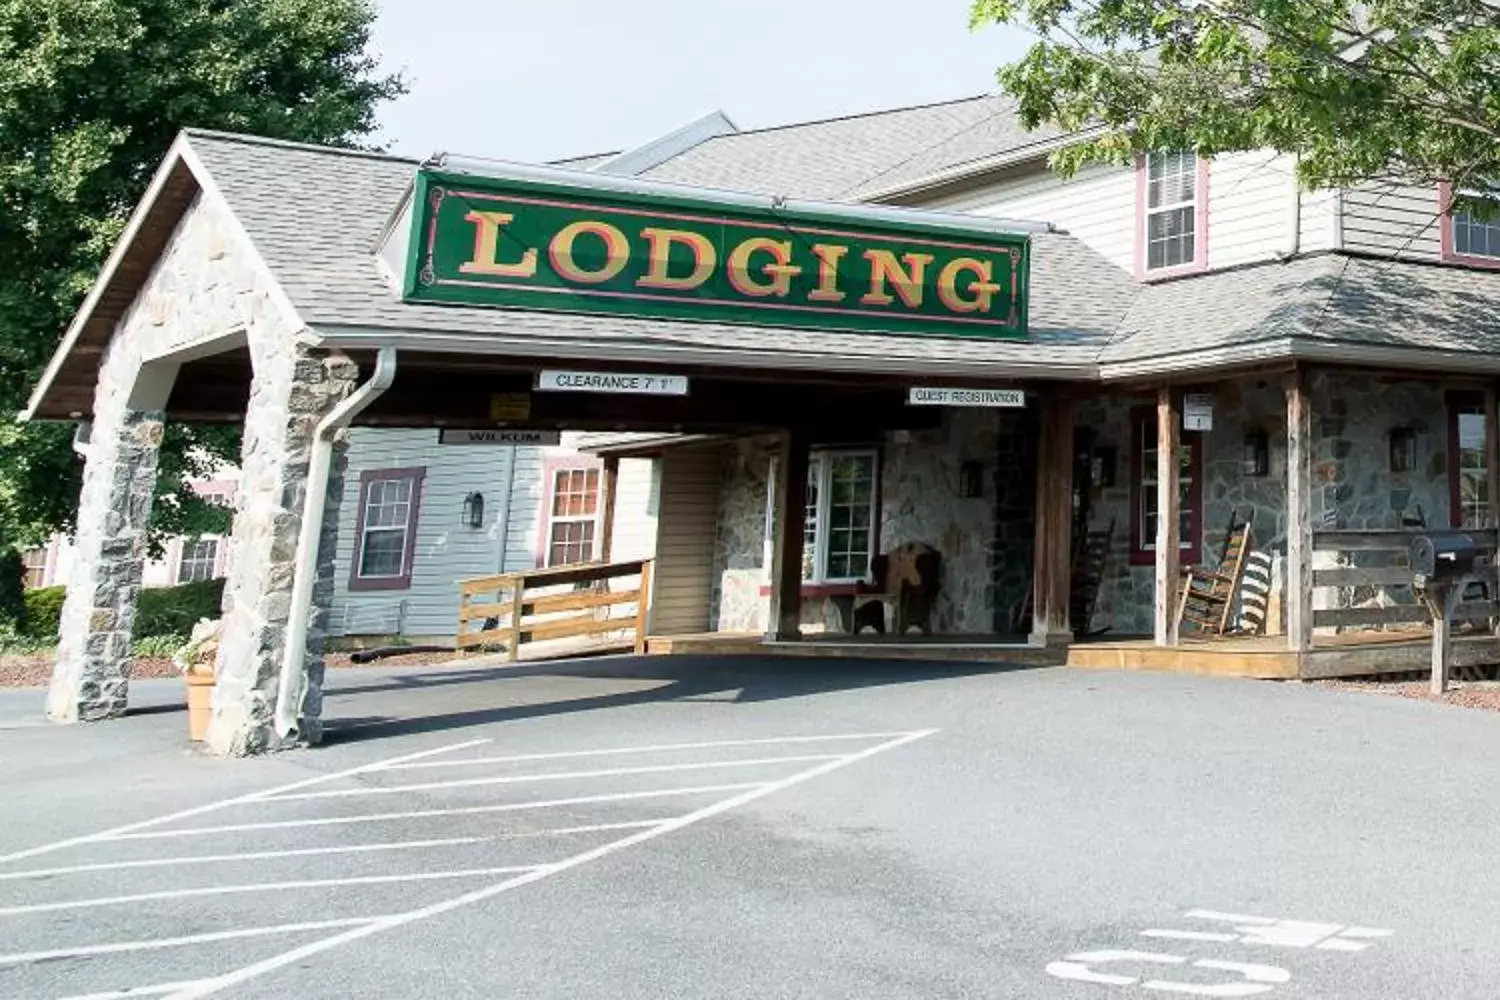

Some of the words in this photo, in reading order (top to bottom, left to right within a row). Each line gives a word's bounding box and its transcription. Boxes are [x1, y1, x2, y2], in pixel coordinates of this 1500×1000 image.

[459, 210, 1001, 313] LODGING
[555, 373, 639, 389] CLEARANCE
[915, 390, 949, 401] GUEST
[951, 391, 1020, 403] REGISTRATION
